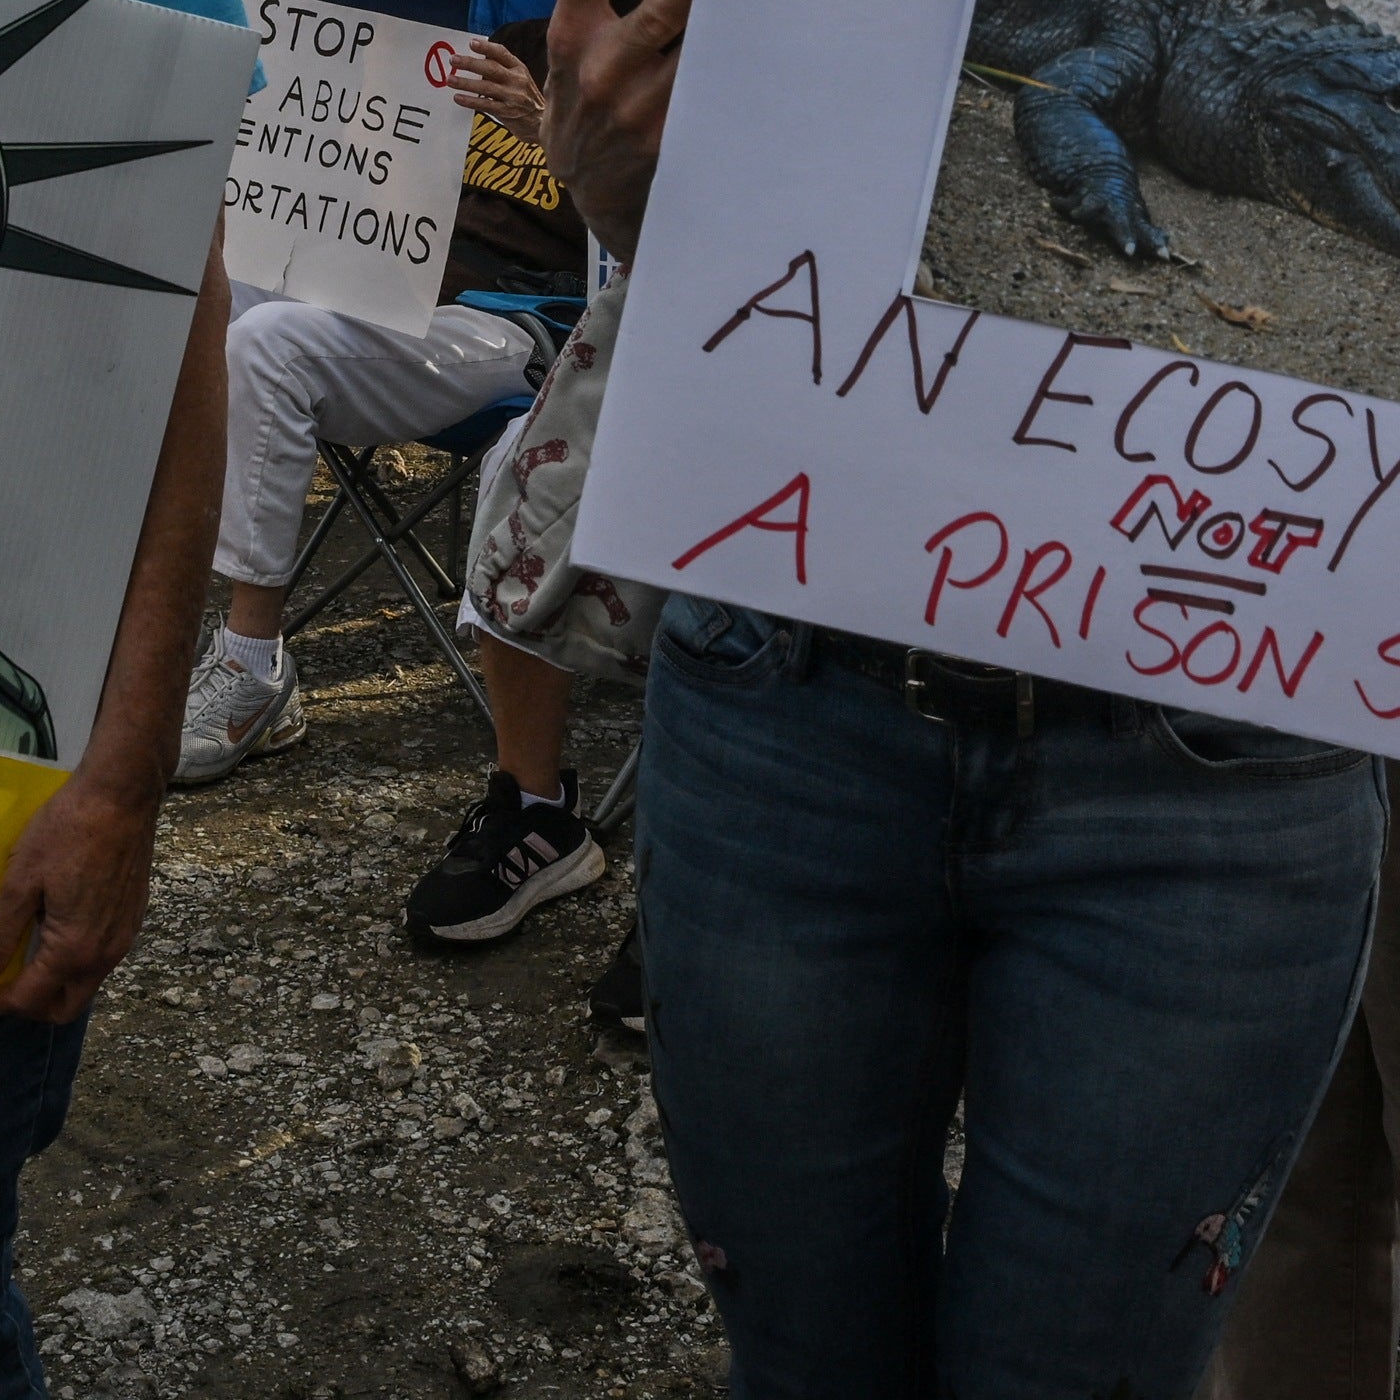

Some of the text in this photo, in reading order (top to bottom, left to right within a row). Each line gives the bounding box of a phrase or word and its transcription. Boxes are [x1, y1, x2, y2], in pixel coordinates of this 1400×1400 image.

[235, 117, 394, 186] ENTIONS
[278, 75, 431, 145] ABUSE
[223, 175, 438, 266] ORTATIONS
[462, 148, 566, 211] AMILIES
[701, 248, 981, 415] AN
[1110, 473, 1325, 574] NOT
[670, 471, 810, 586] A
[923, 510, 1325, 699] PRISON
